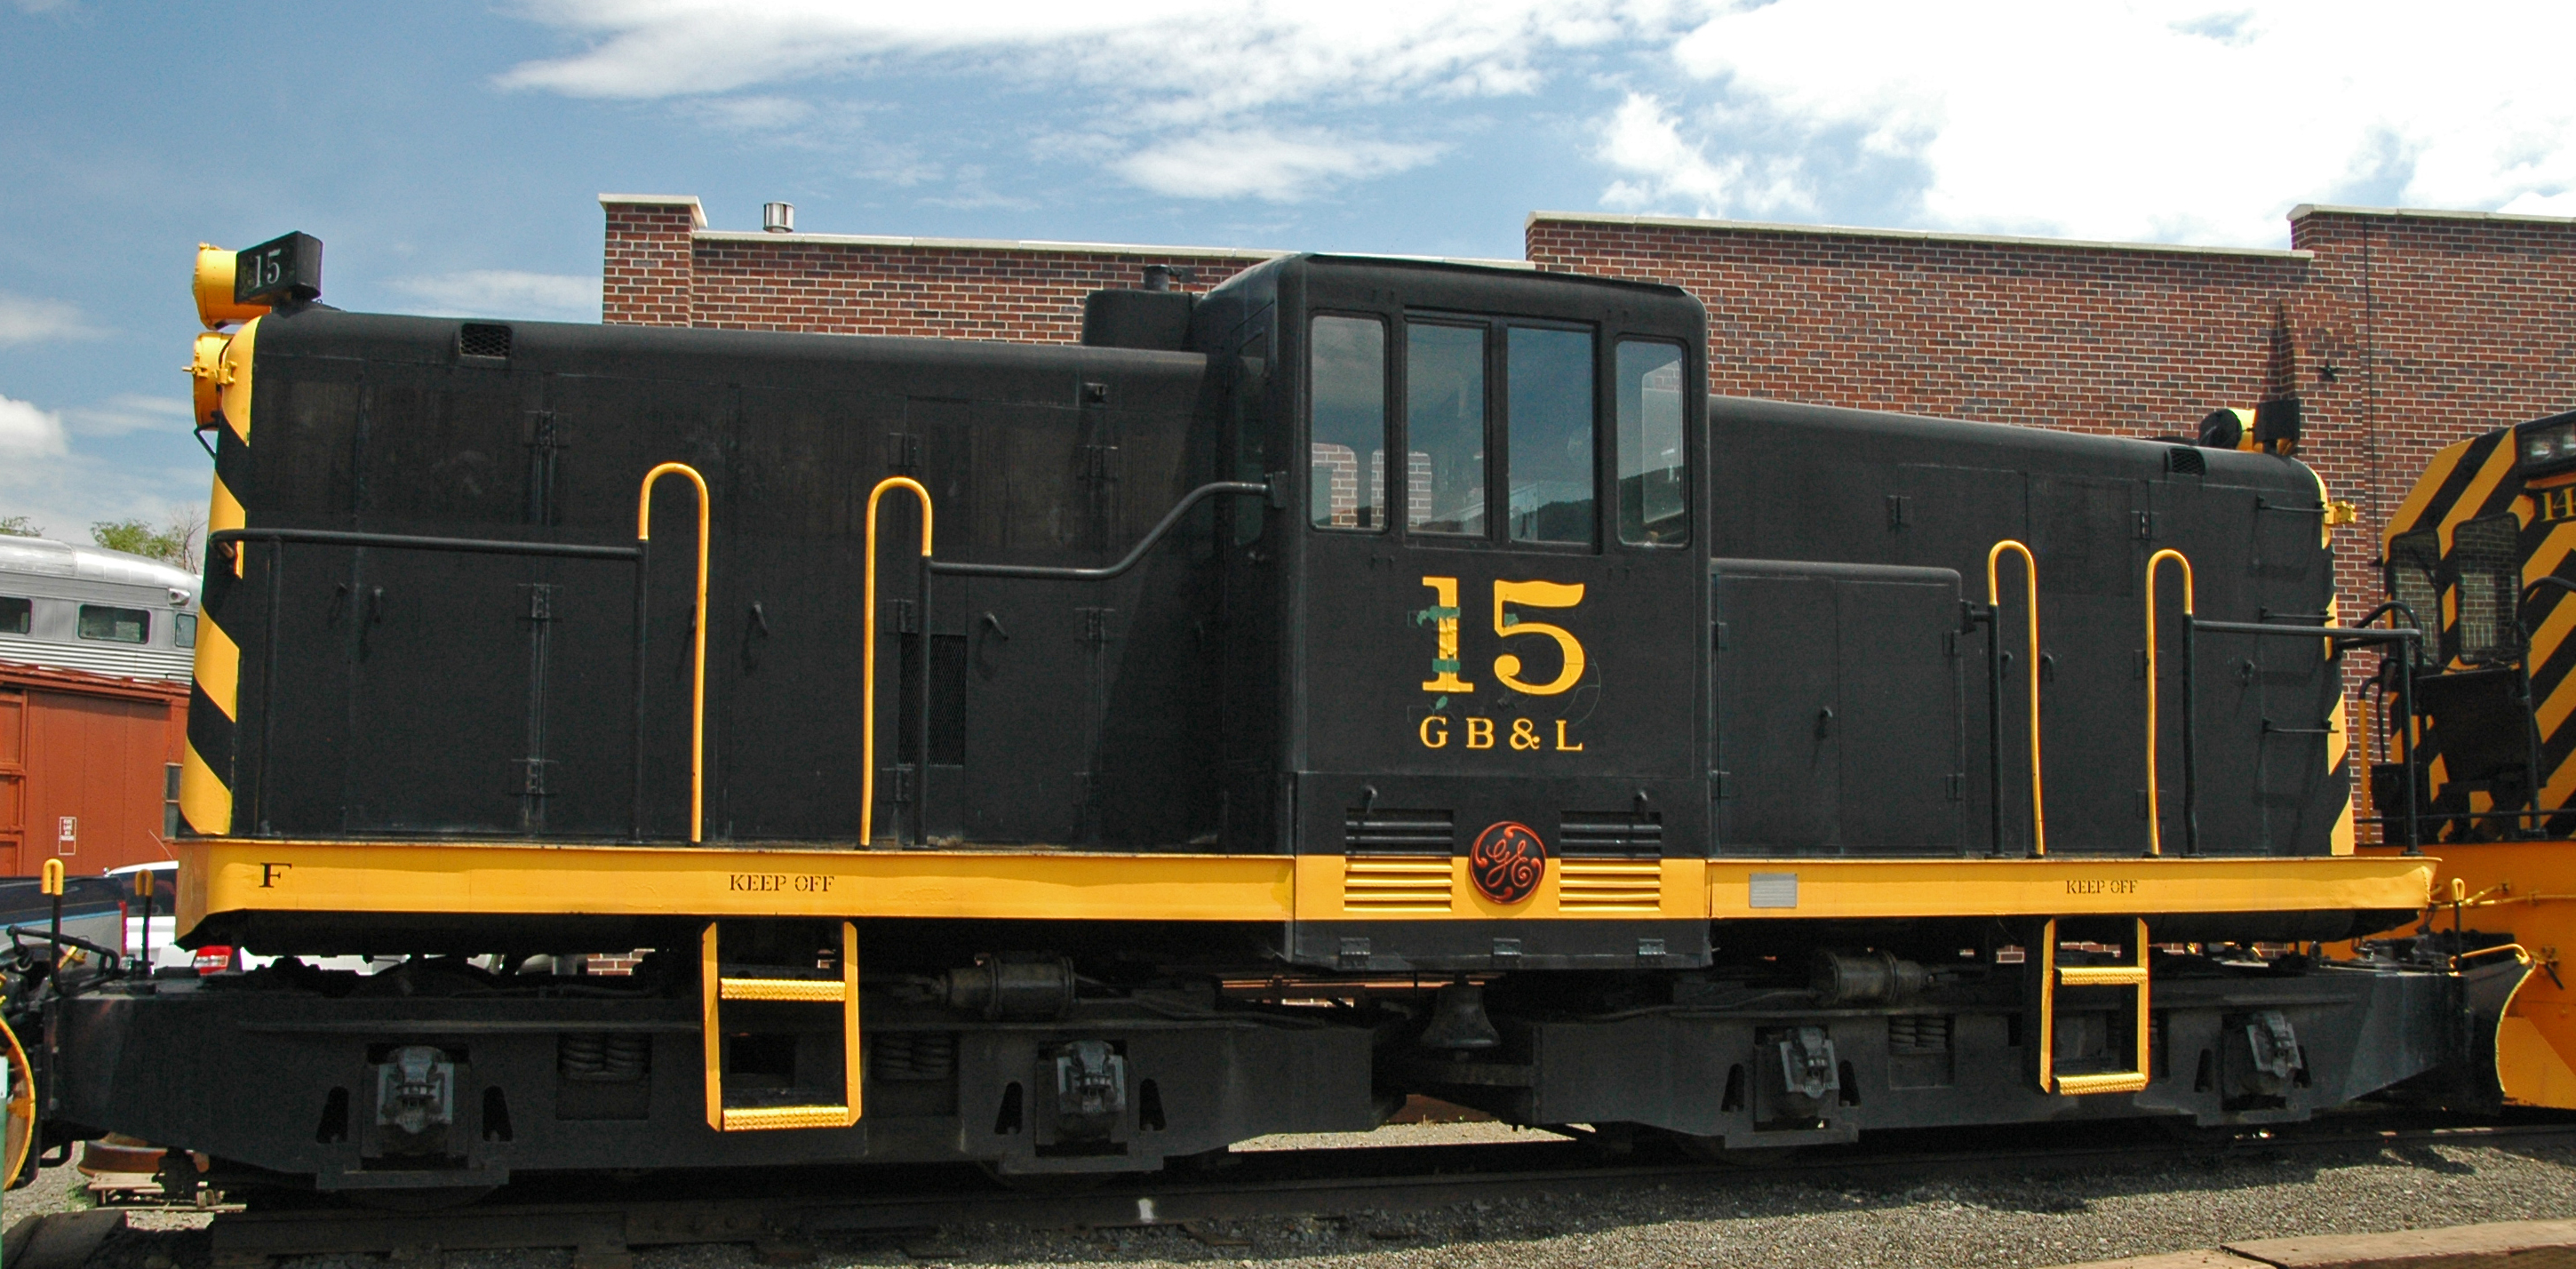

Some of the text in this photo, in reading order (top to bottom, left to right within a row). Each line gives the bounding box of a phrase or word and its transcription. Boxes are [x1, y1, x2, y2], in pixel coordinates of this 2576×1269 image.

[255, 249, 281, 288] 15
[1422, 576, 1584, 695] 15
[259, 862, 292, 888] F
[730, 874, 835, 892] KEEP OFF
[2066, 880, 2139, 894] KEEP OFF
